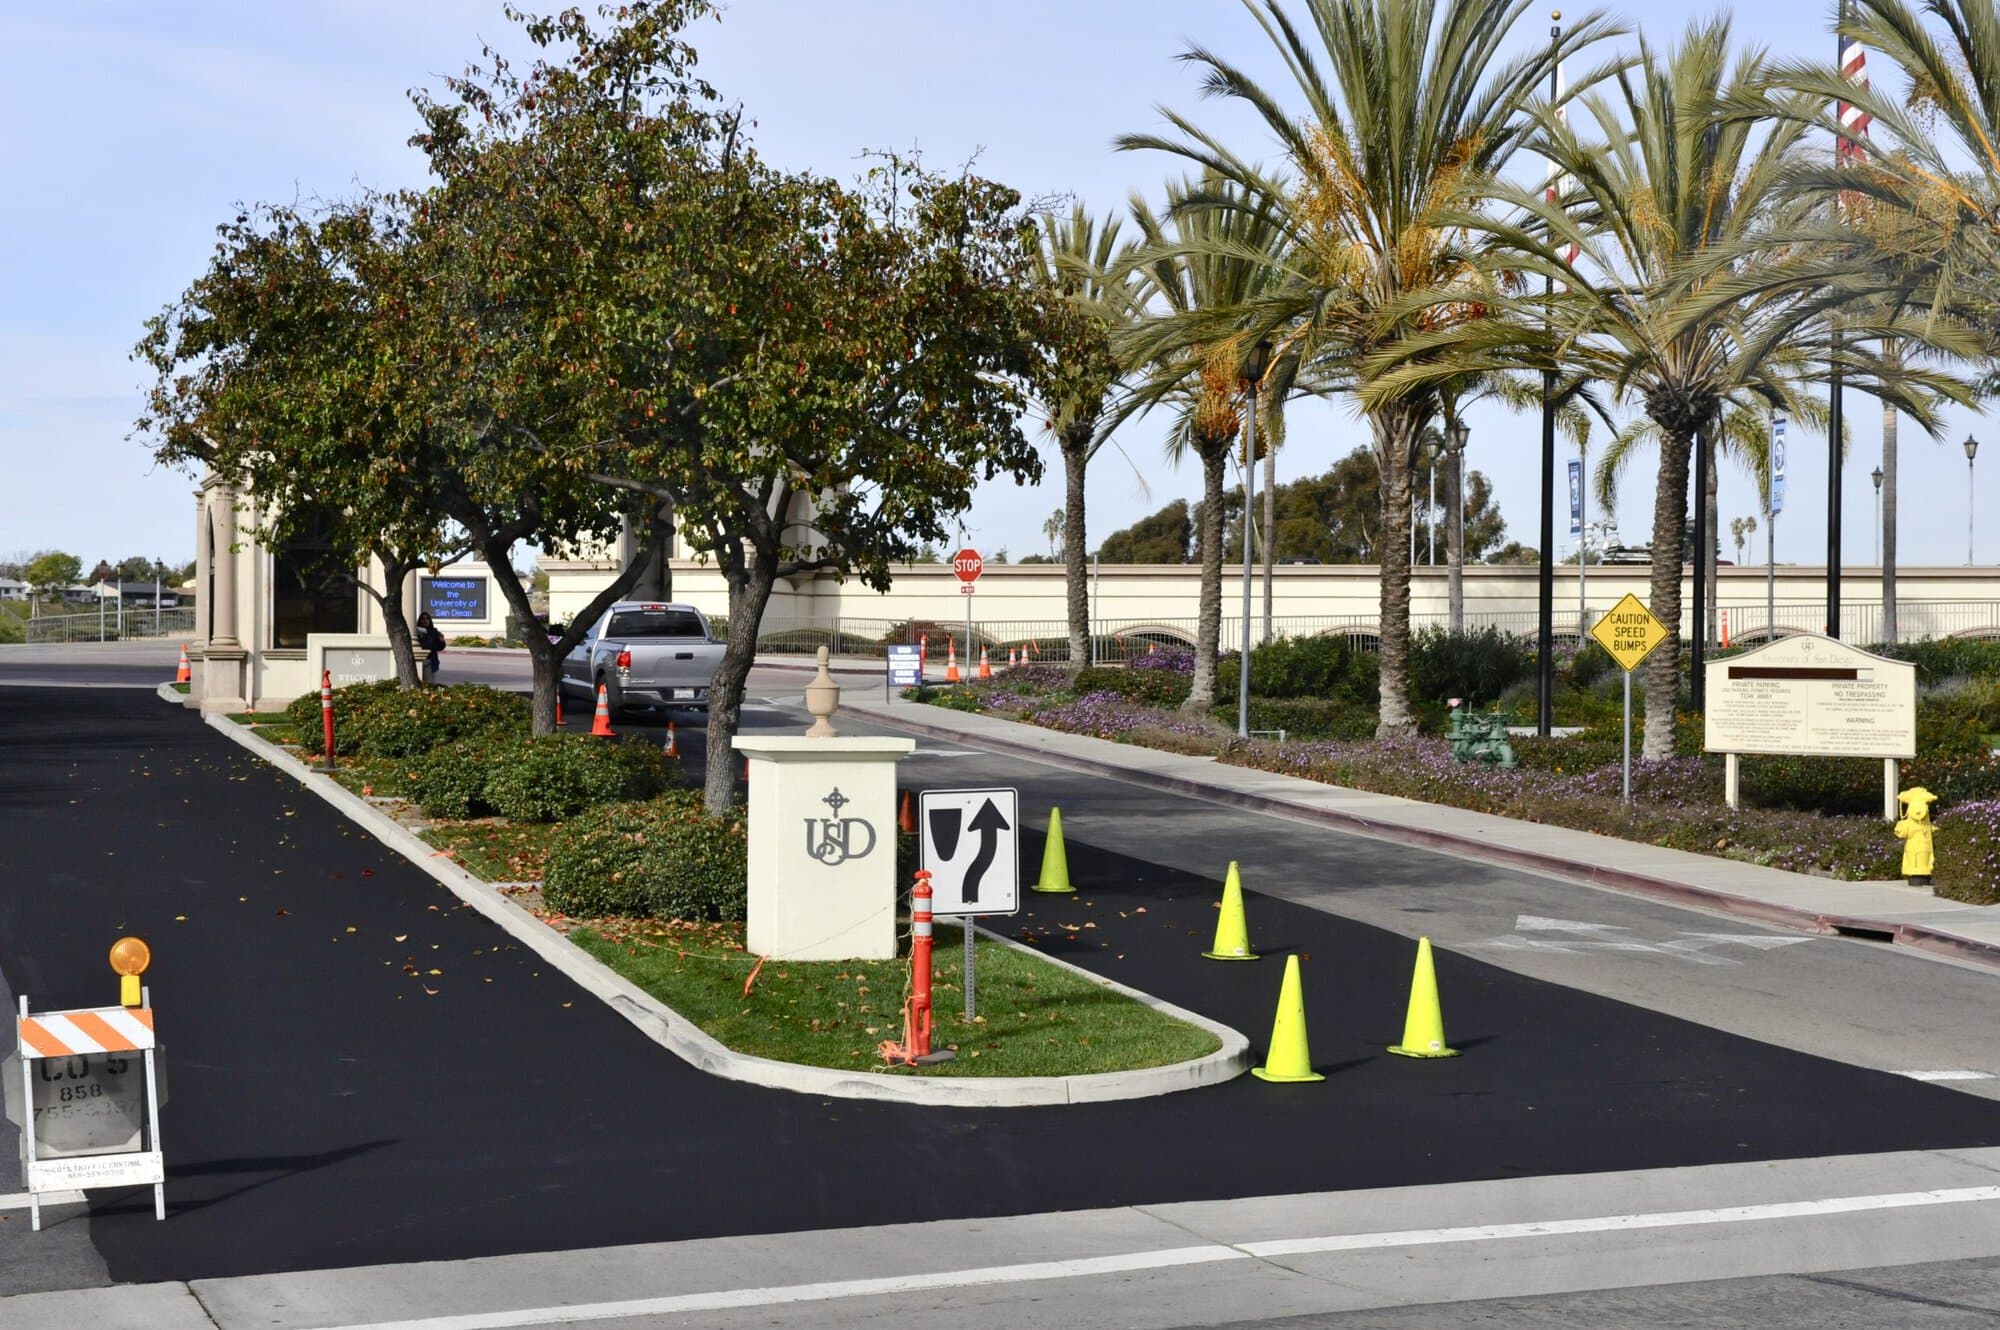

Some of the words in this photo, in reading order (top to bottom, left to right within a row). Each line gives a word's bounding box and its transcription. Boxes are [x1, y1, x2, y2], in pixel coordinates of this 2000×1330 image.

[955, 559, 980, 572] STOP
[431, 600, 467, 608] University
[452, 609, 472, 617] Diego
[1610, 613, 1649, 624] CAUTION
[1615, 627, 1646, 638] SPEED
[1614, 640, 1646, 651] BUMPS
[803, 818, 876, 866] USD
[60, 1083, 102, 1102] 858
